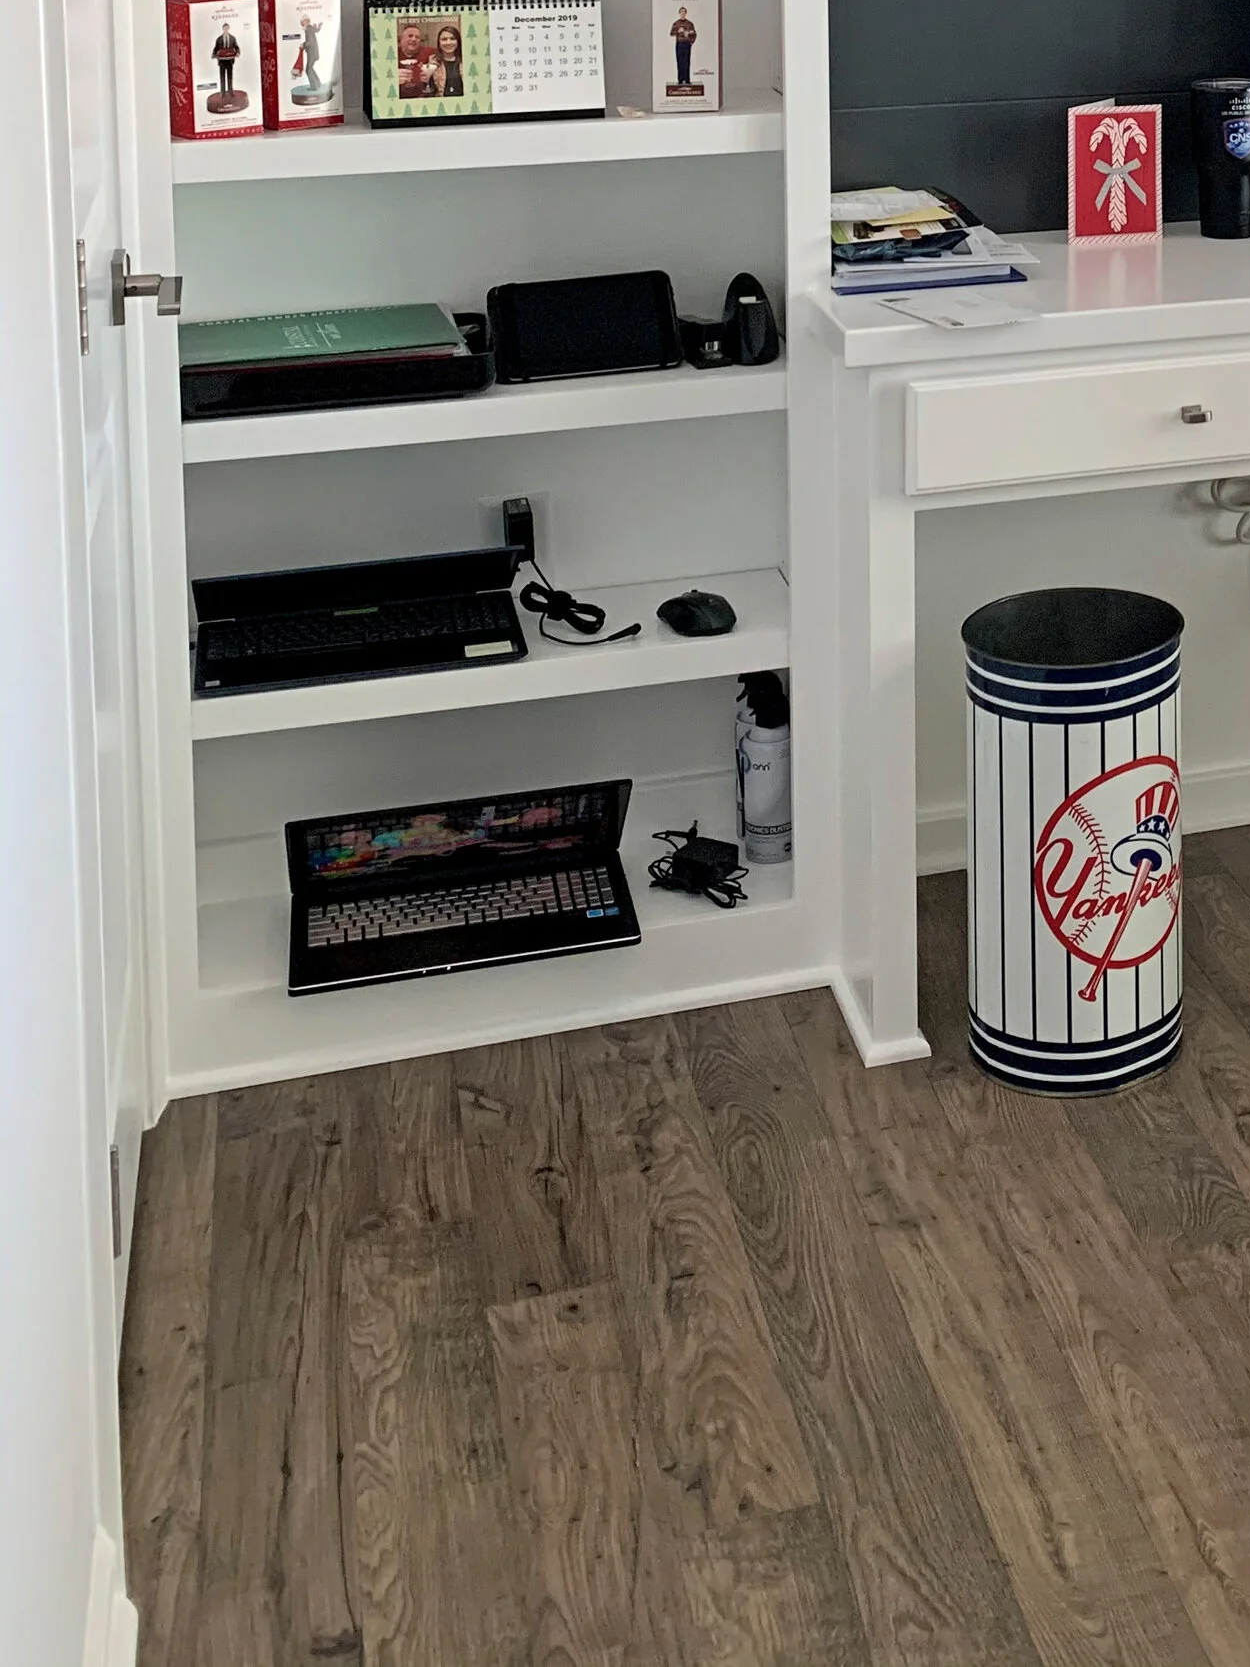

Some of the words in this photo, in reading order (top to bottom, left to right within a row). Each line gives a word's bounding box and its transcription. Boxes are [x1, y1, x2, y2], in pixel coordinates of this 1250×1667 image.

[573, 69, 583, 77] 27
[752, 762, 770, 771] onn
[1034, 837, 1182, 931] Yankee
